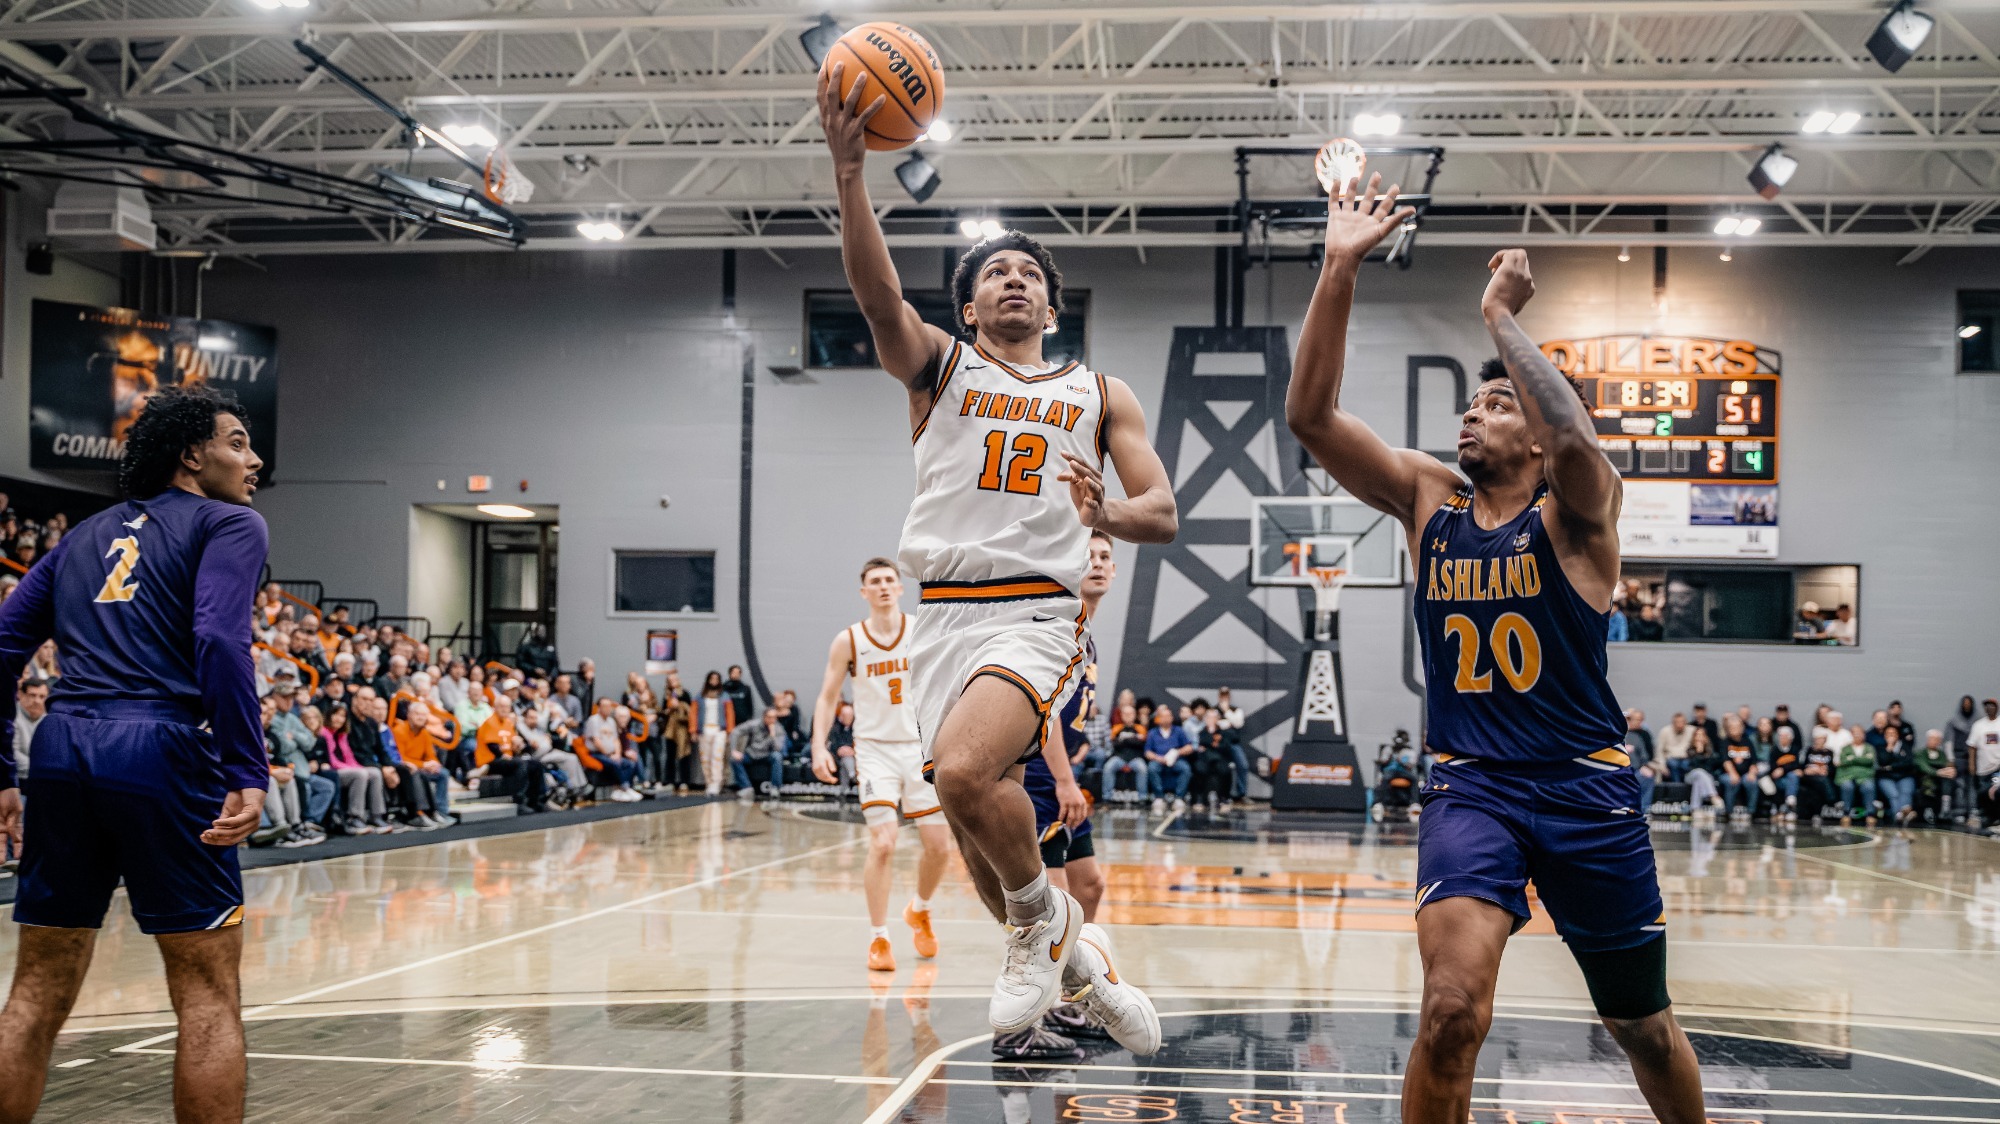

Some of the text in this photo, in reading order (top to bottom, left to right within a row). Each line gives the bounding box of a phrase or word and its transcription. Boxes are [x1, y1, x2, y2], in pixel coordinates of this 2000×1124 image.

[865, 32, 927, 106] Wilson
[1541, 339, 1758, 374] OILERS
[959, 389, 1084, 432] FINDLAY
[1621, 380, 1689, 407] 8:39
[1724, 395, 1760, 423] 51
[1656, 413, 1672, 436] 2
[977, 430, 1048, 496] 12
[1707, 449, 1726, 473] 2
[1745, 450, 1762, 471] 4
[93, 535, 140, 603] 2
[1427, 553, 1541, 601] ASHLAND
[1444, 612, 1542, 693] 20
[888, 678, 902, 704] 2
